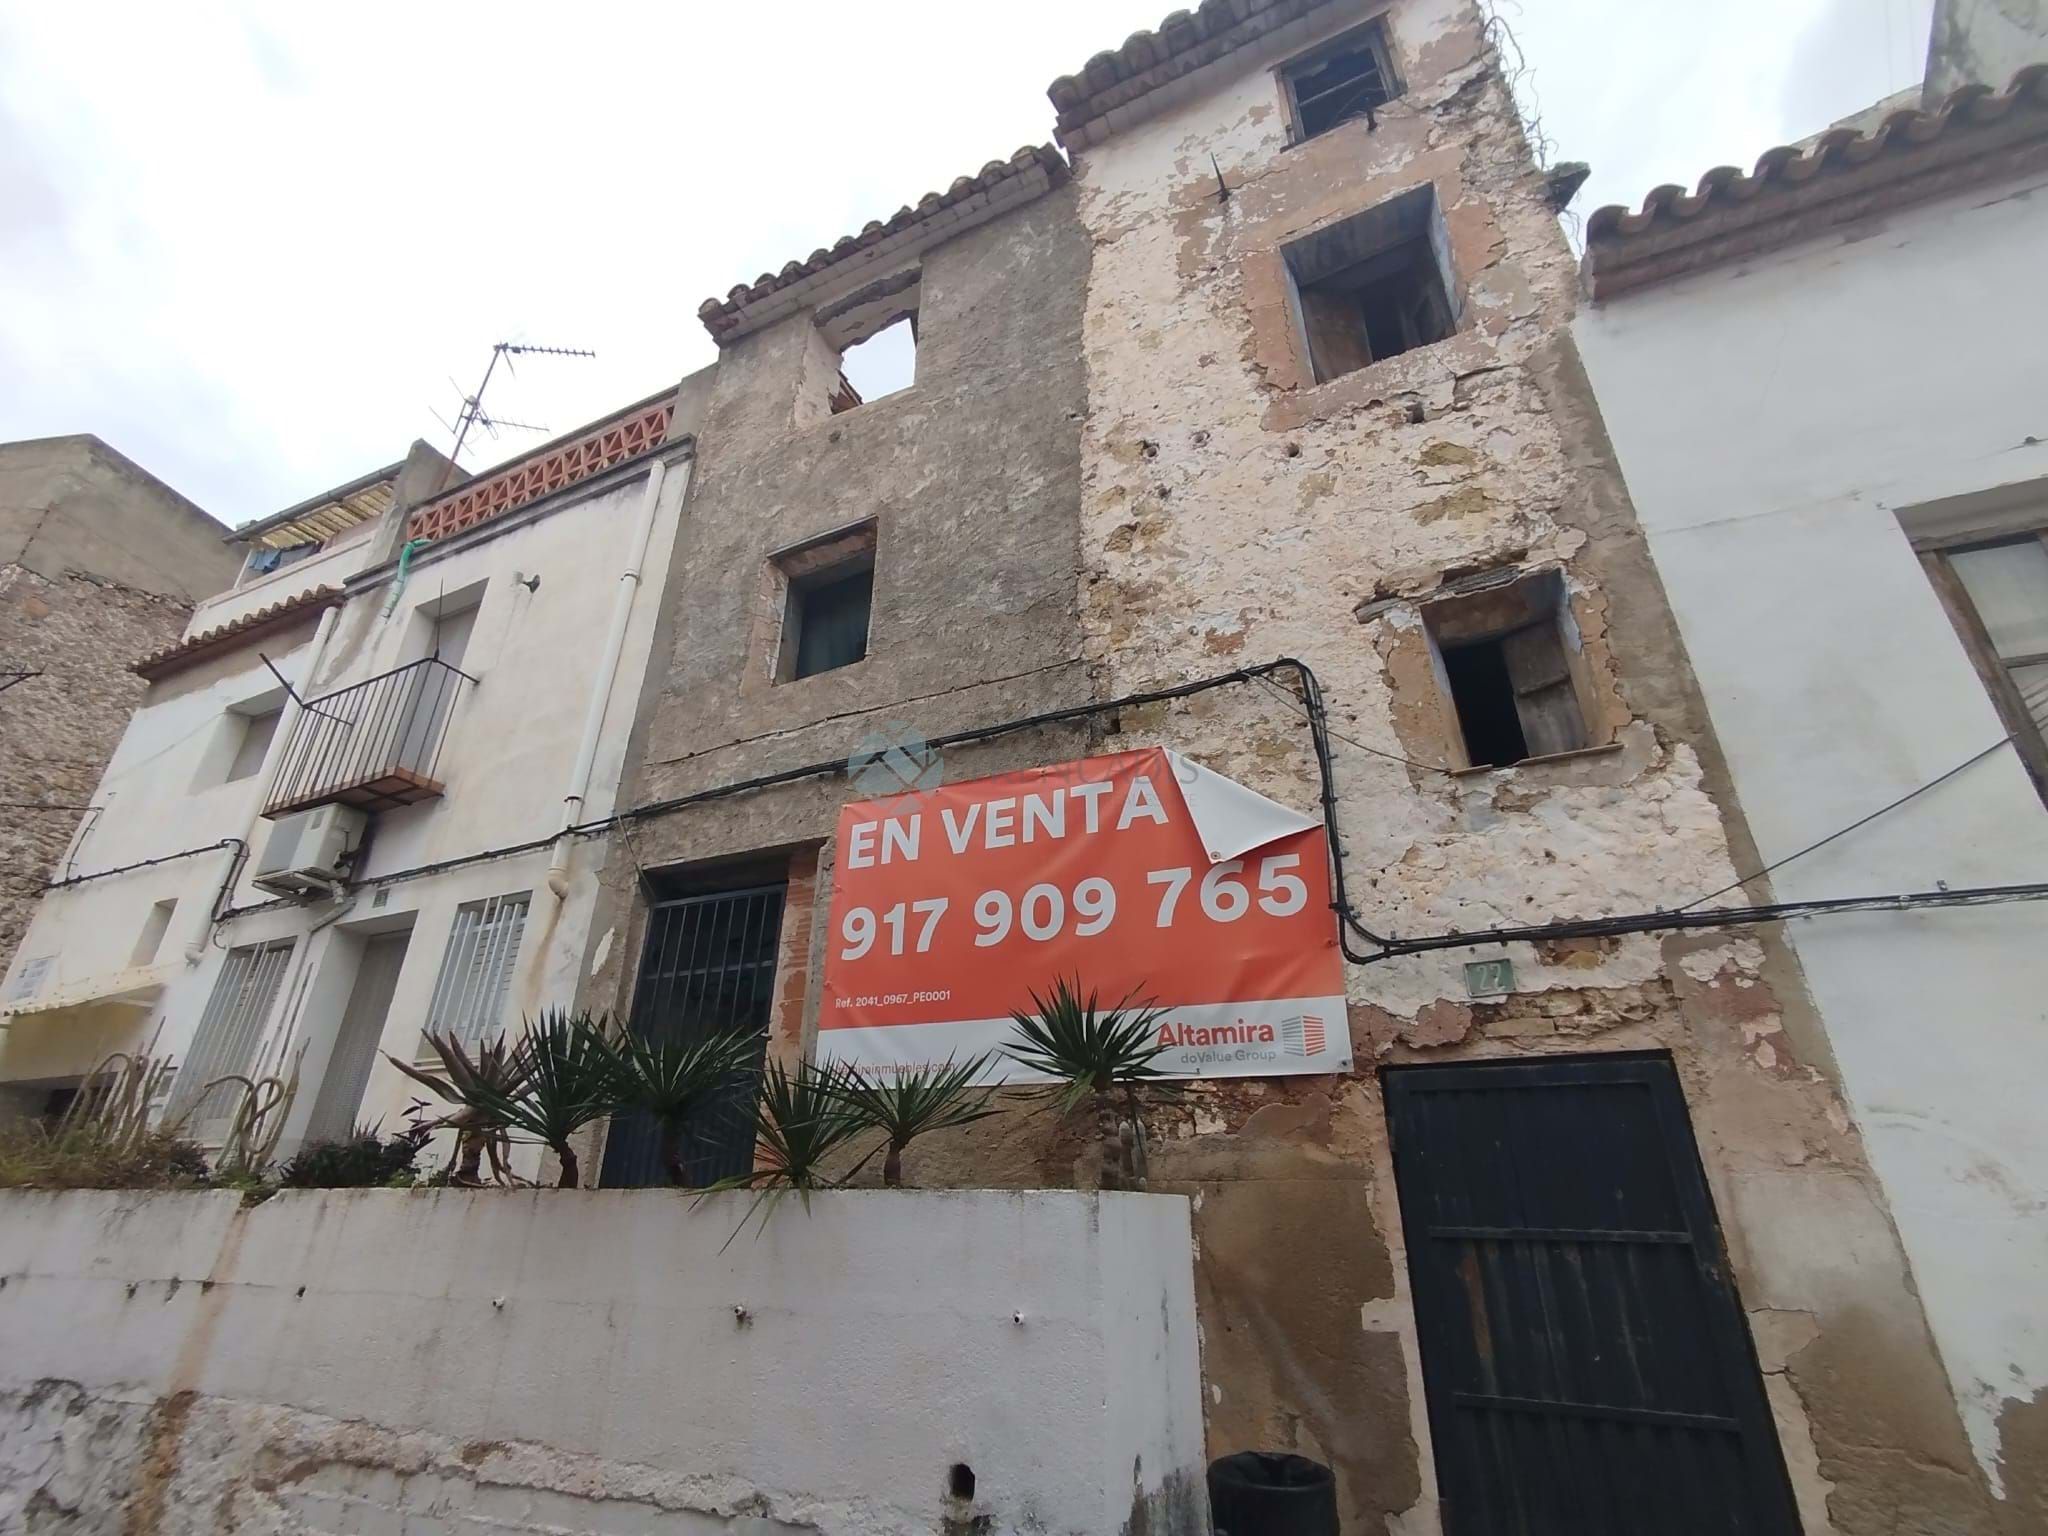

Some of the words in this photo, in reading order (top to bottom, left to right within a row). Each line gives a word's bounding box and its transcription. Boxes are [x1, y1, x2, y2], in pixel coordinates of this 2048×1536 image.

[847, 814, 922, 870] EN
[940, 776, 1170, 855] VENTA
[841, 897, 949, 962] 917
[974, 877, 1117, 948] 909
[1147, 853, 1308, 930] 765
[835, 997, 854, 1009] Ref.
[1157, 1018, 1275, 1047] Altamira
[1181, 1051, 1232, 1064] doValue
[1234, 1049, 1277, 1063] Group
